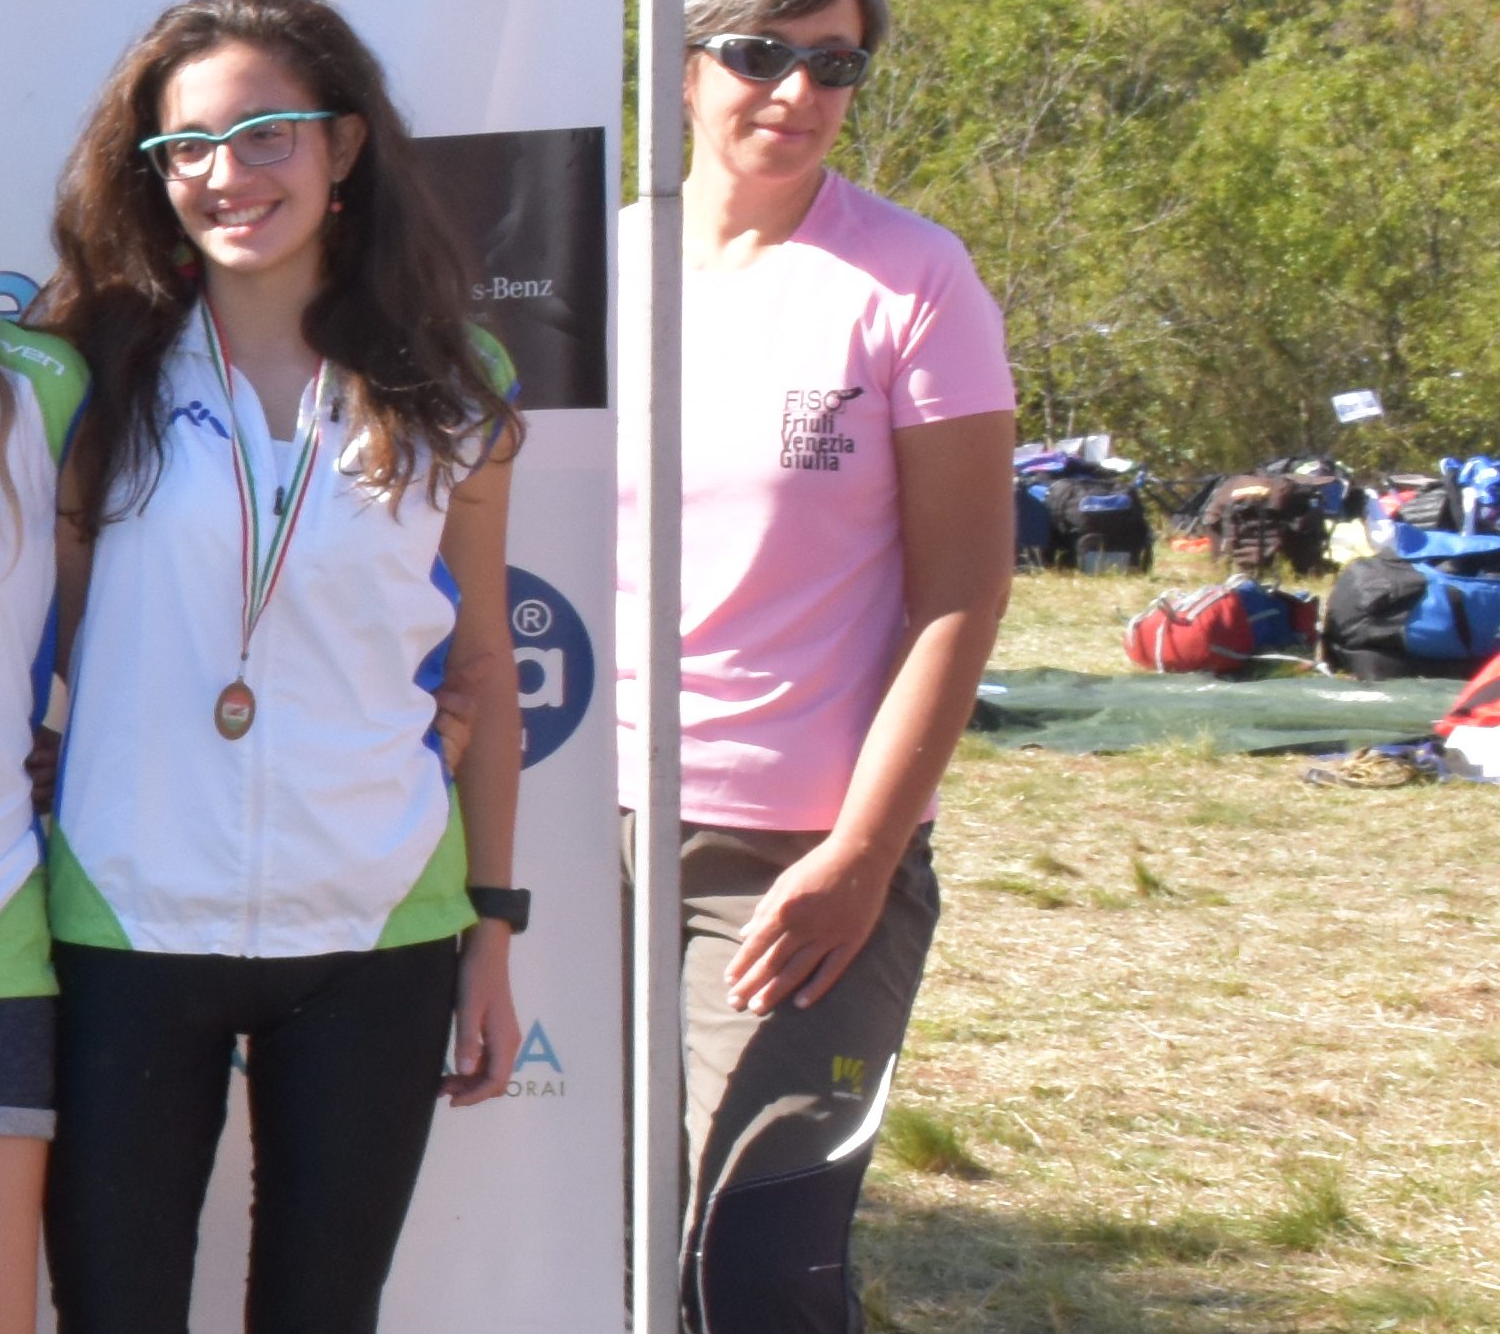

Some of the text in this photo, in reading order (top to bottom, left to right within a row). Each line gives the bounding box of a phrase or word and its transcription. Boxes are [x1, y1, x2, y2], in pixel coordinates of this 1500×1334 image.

[782, 413, 835, 434] Friuli
[781, 431, 855, 453] Venezia
[781, 449, 840, 471] Giulia
[506, 1080, 566, 1097] ORAI
